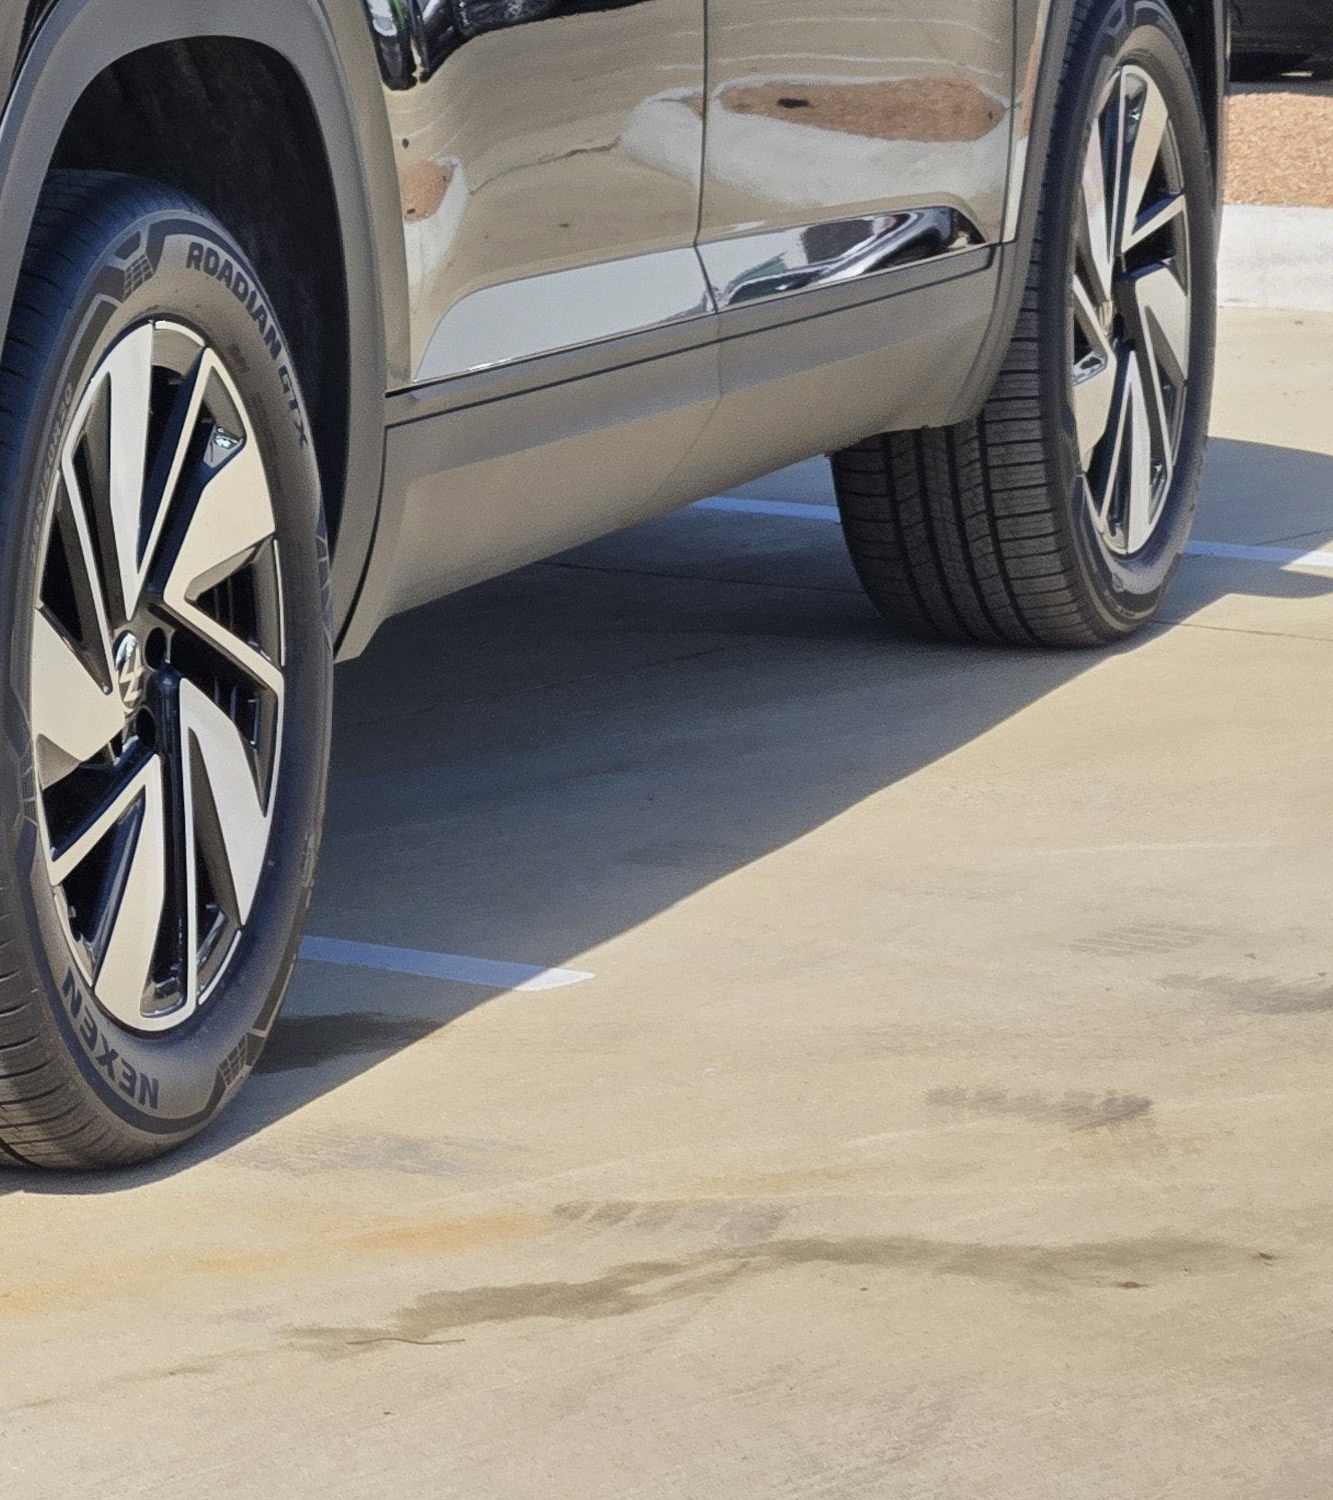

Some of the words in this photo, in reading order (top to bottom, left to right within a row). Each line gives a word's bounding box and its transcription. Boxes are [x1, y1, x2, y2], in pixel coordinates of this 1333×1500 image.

[186, 241, 282, 361] ROADIAN
[278, 365, 309, 449] GTX
[61, 965, 160, 1110] NEXEN
